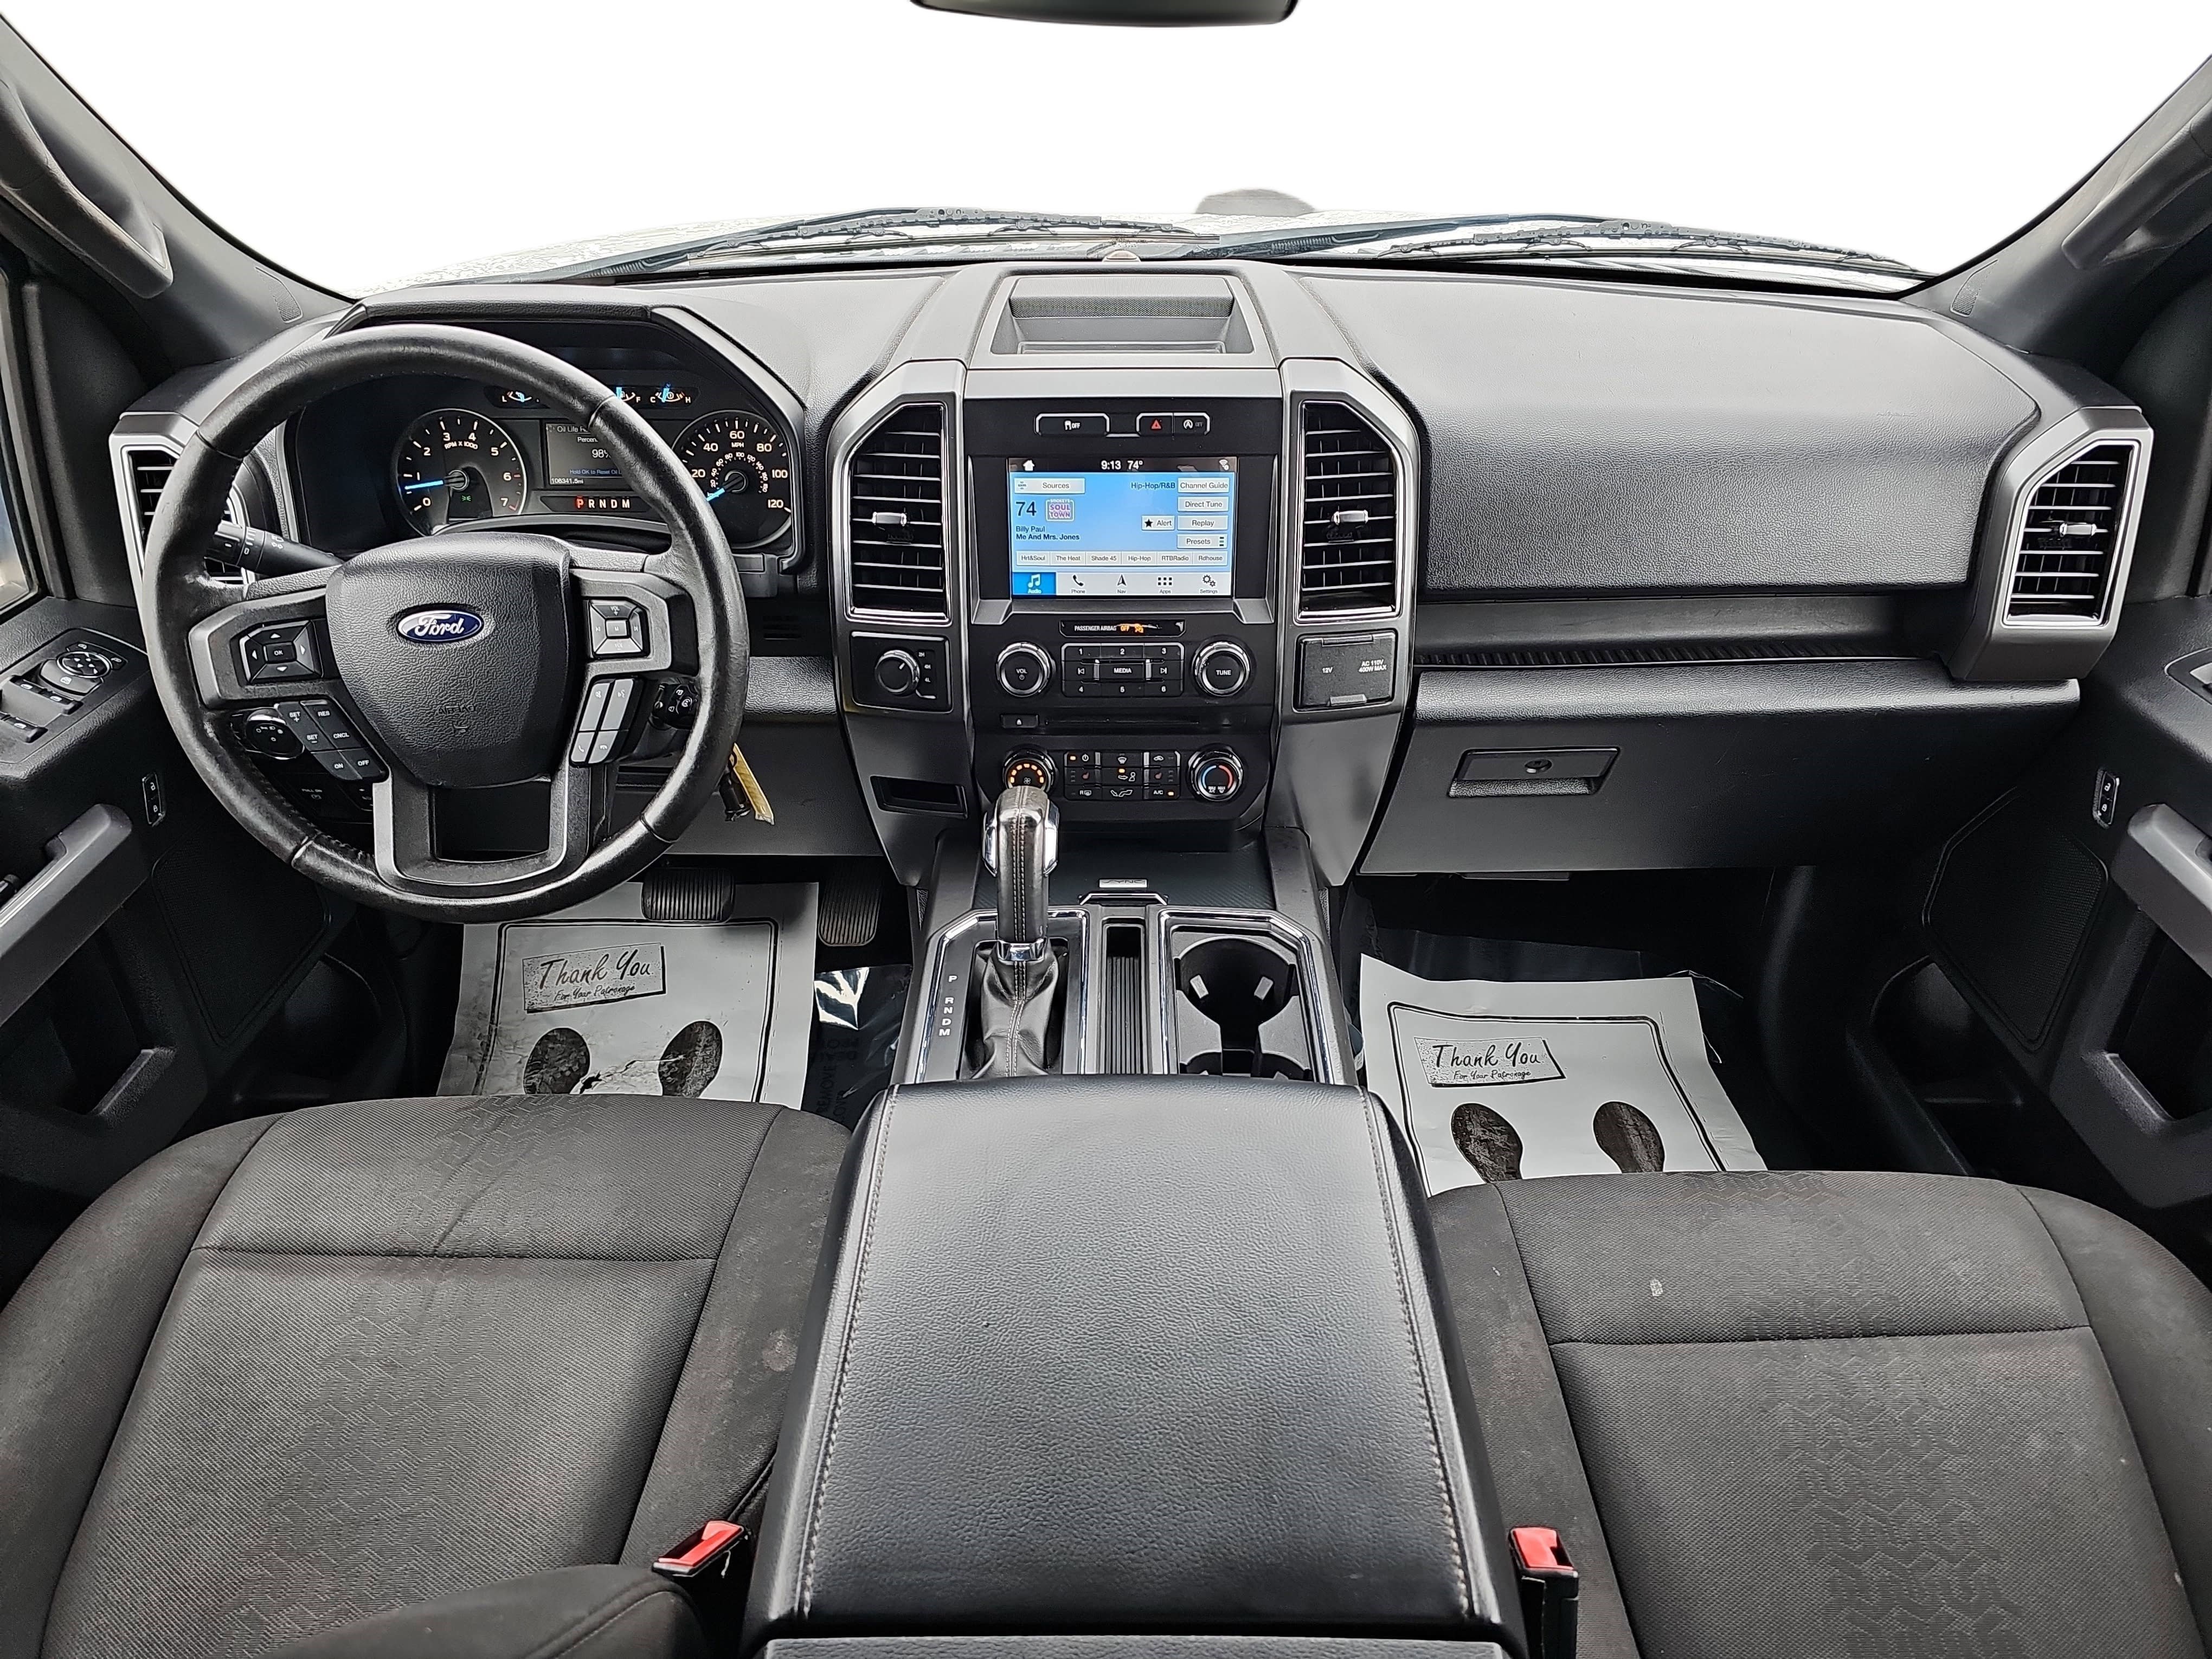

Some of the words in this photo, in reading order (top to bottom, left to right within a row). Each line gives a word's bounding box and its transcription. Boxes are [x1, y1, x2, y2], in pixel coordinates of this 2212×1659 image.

[443, 433, 451, 441] 3
[468, 433, 477, 441] 4
[729, 430, 745, 439] 60
[444, 441, 457, 449] RPM
[464, 441, 478, 449] 1000
[703, 443, 718, 452] 40
[756, 443, 772, 452] 80
[423, 447, 431, 456] 2
[491, 447, 499, 456] 5
[1101, 460, 1121, 470] 9:13
[417, 472, 420, 480] 1
[503, 472, 511, 481] 6
[691, 469, 706, 478] 20
[771, 469, 788, 478] 100
[1131, 482, 1175, 490] Hip-Hop/R&B
[422, 497, 431, 506] 0
[500, 498, 508, 506] 7
[576, 499, 584, 508] P
[588, 499, 595, 508] R
[600, 499, 606, 508] N
[610, 499, 618, 508] D
[622, 499, 630, 508] M
[768, 499, 784, 508] 120
[1015, 501, 1037, 516] 74
[414, 614, 465, 636] Ford
[539, 953, 610, 990] Thank
[616, 949, 652, 980] You
[554, 989, 569, 1001] For
[573, 987, 592, 999] Your
[938, 1028, 950, 1037] M
[1432, 1044, 1499, 1068] Thank
[1505, 1041, 1541, 1068] You
[1454, 1070, 1466, 1079] For
[1470, 1070, 1489, 1079] Your
[1491, 1069, 1531, 1079] Patronage
